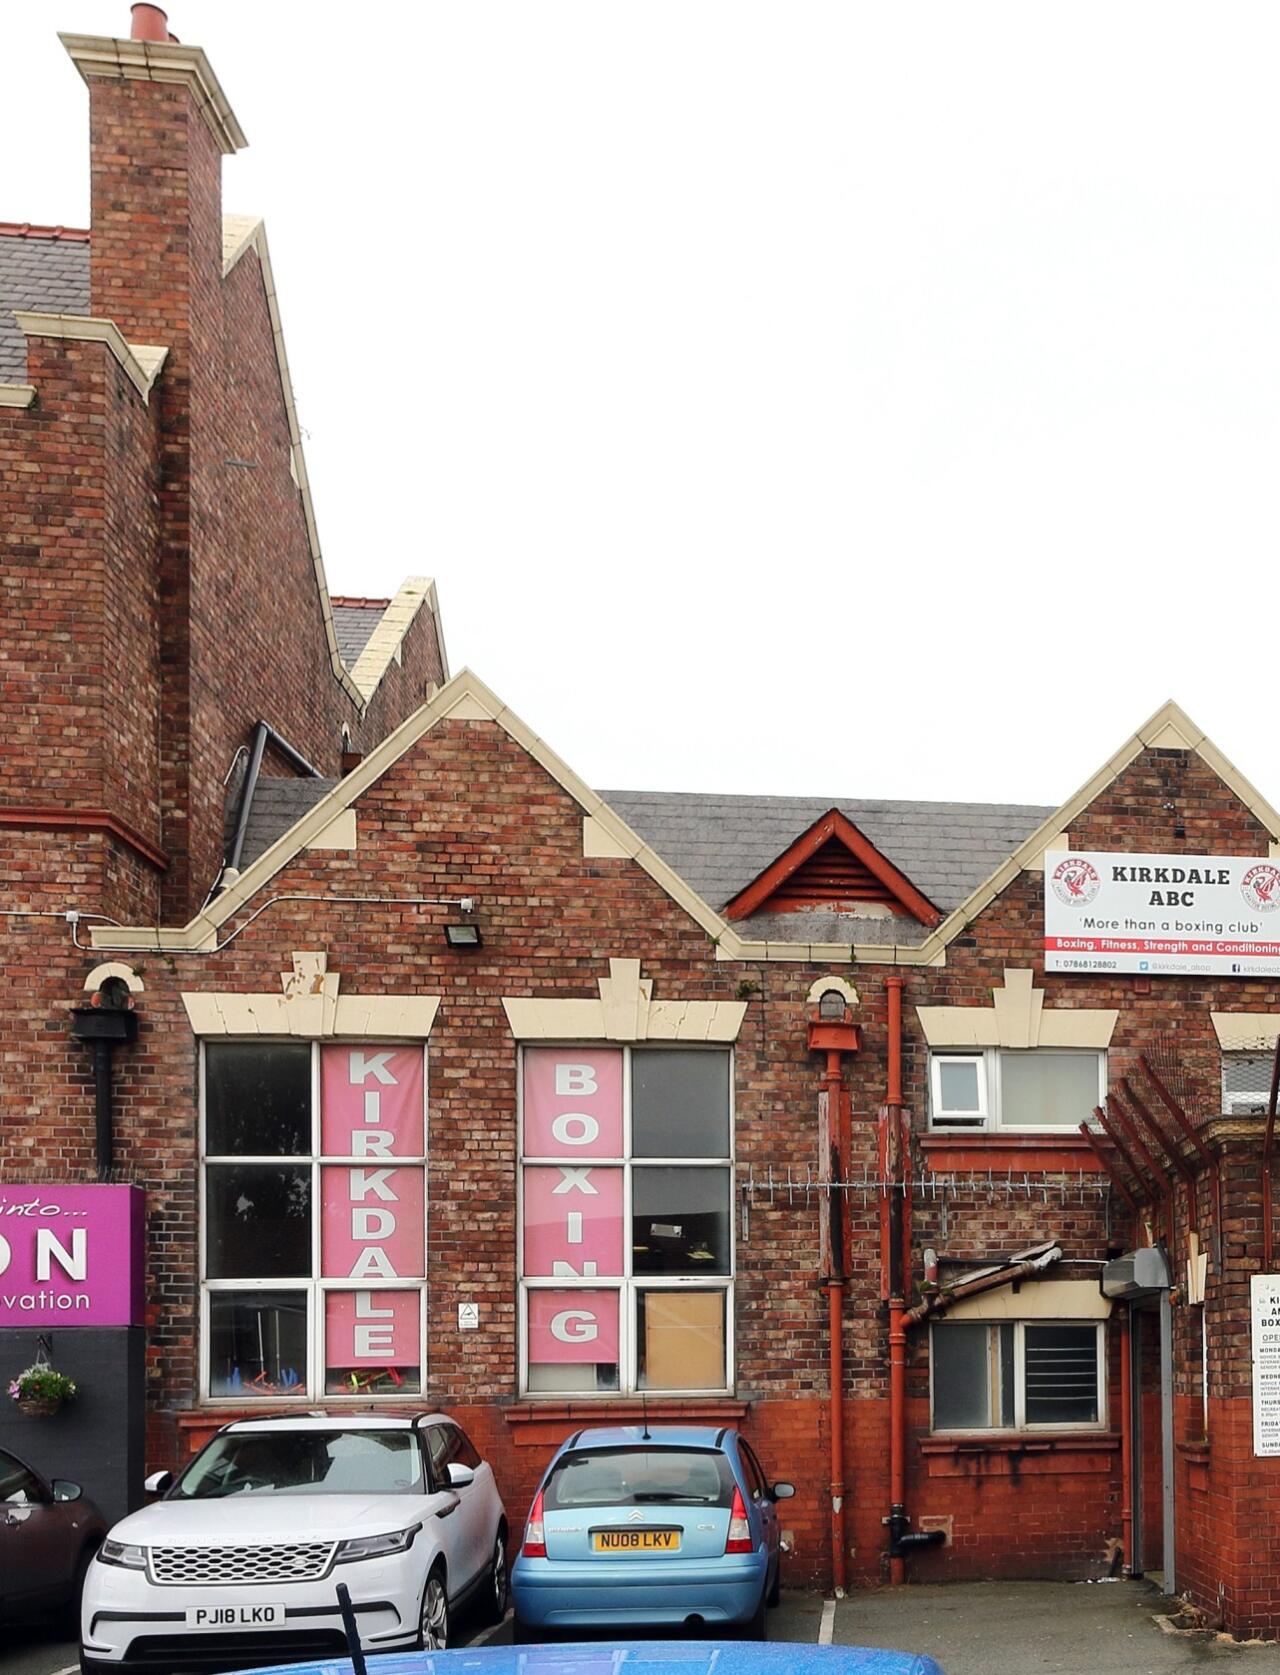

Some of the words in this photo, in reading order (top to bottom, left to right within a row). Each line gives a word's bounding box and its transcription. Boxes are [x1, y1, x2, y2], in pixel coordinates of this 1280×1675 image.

[1112, 866, 1230, 885] KIRKDALE
[1149, 891, 1194, 907] ABC
[1125, 919, 1156, 931] than
[1161, 921, 1170, 931] a
[1175, 920, 1223, 934] boxing
[1056, 939, 1097, 950] Boxing,
[1101, 940, 1140, 951] Fitness,
[1143, 941, 1188, 953] Strength
[1192, 942, 1213, 952] and
[1063, 960, 1117, 969] 07868128802
[348, 1051, 399, 1358] KIRKDALE
[0, 1228, 87, 1282] N
[3, 1290, 90, 1310] vation
[601, 1533, 640, 1548] NU08
[643, 1532, 672, 1547] LKV
[196, 1608, 235, 1624] PJ18
[240, 1607, 275, 1623] LKO
